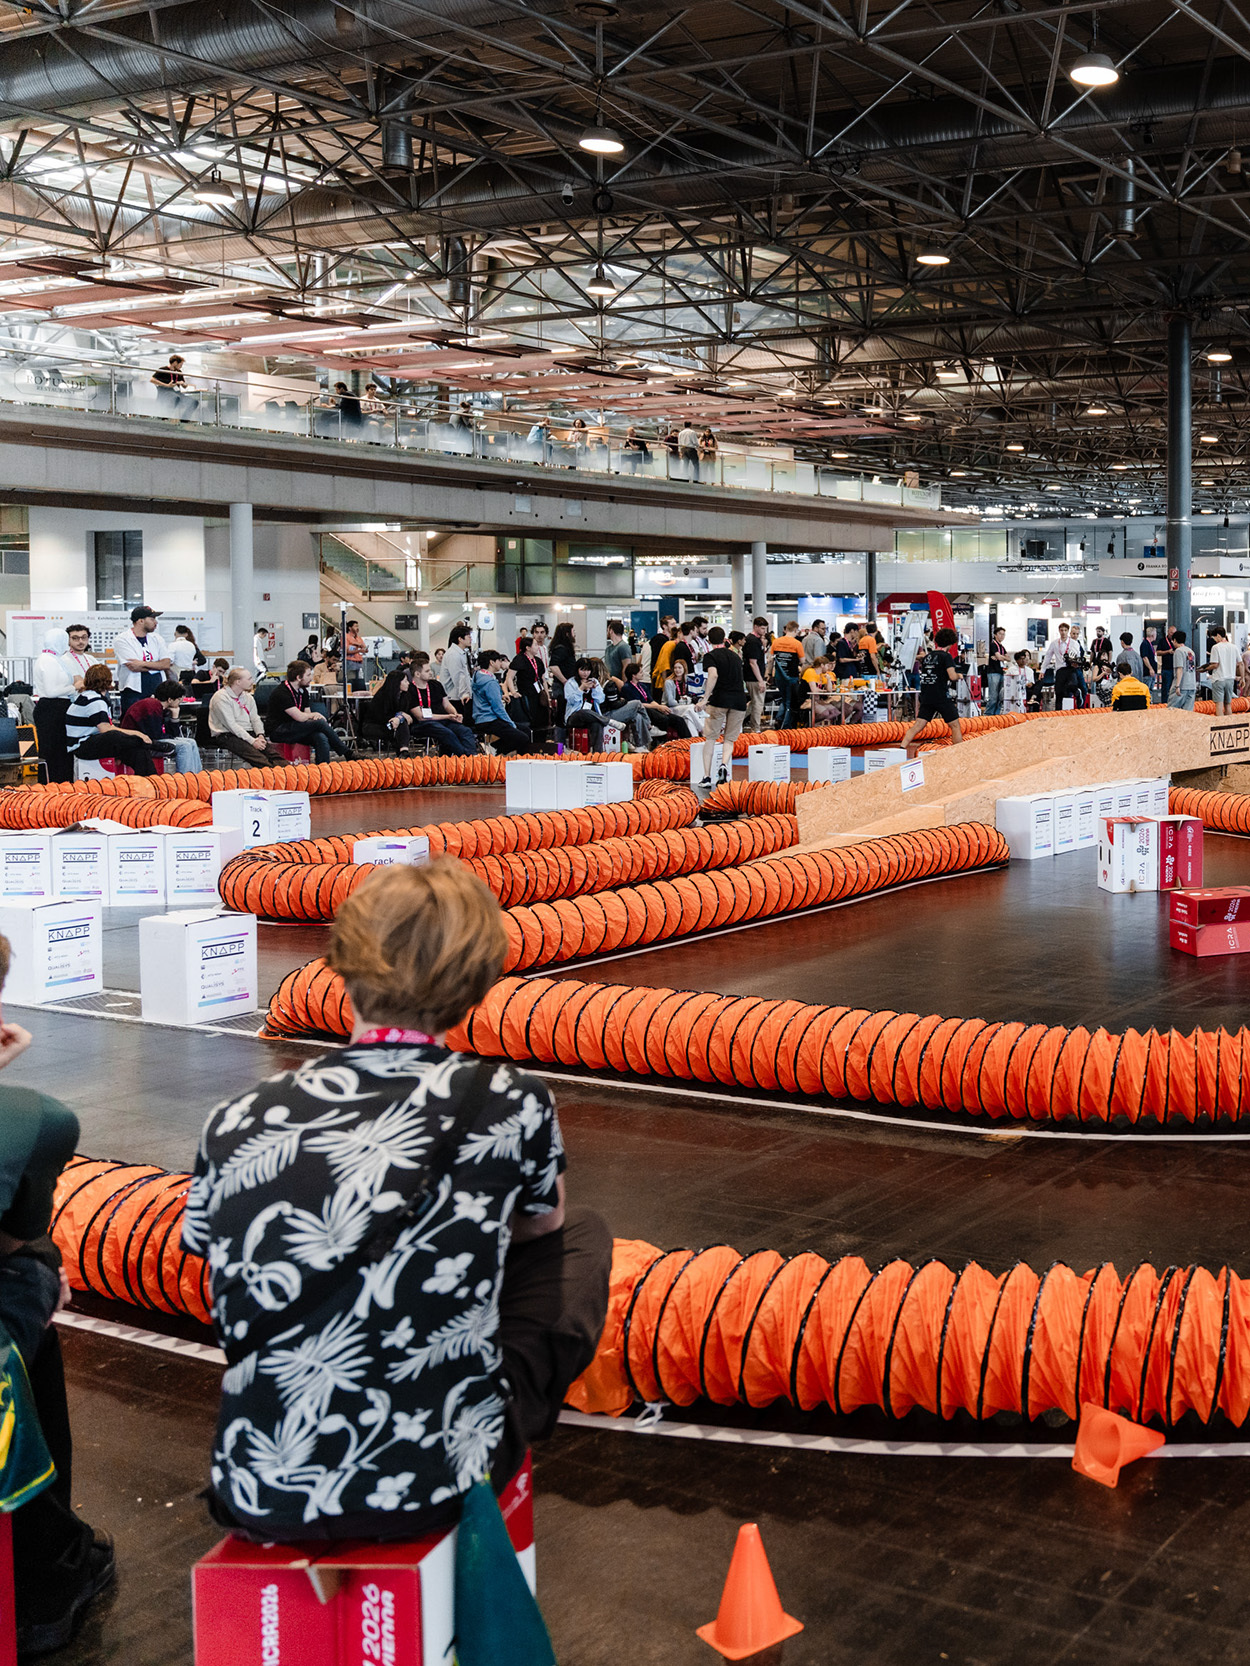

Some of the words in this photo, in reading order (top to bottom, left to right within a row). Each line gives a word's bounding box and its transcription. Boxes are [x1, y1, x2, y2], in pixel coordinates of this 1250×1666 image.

[1209, 728, 1250, 751] KNAPP
[252, 820, 261, 837] 2
[5, 854, 41, 862] KNAPP
[62, 854, 98, 862] KNAPP
[120, 852, 155, 860] KNAPP
[176, 852, 211, 860] KNAPP
[48, 926, 91, 940] KNAPP
[1227, 927, 1236, 949] ICRA
[201, 942, 245, 957] KNAPP
[361, 1583, 380, 1660] 2026
